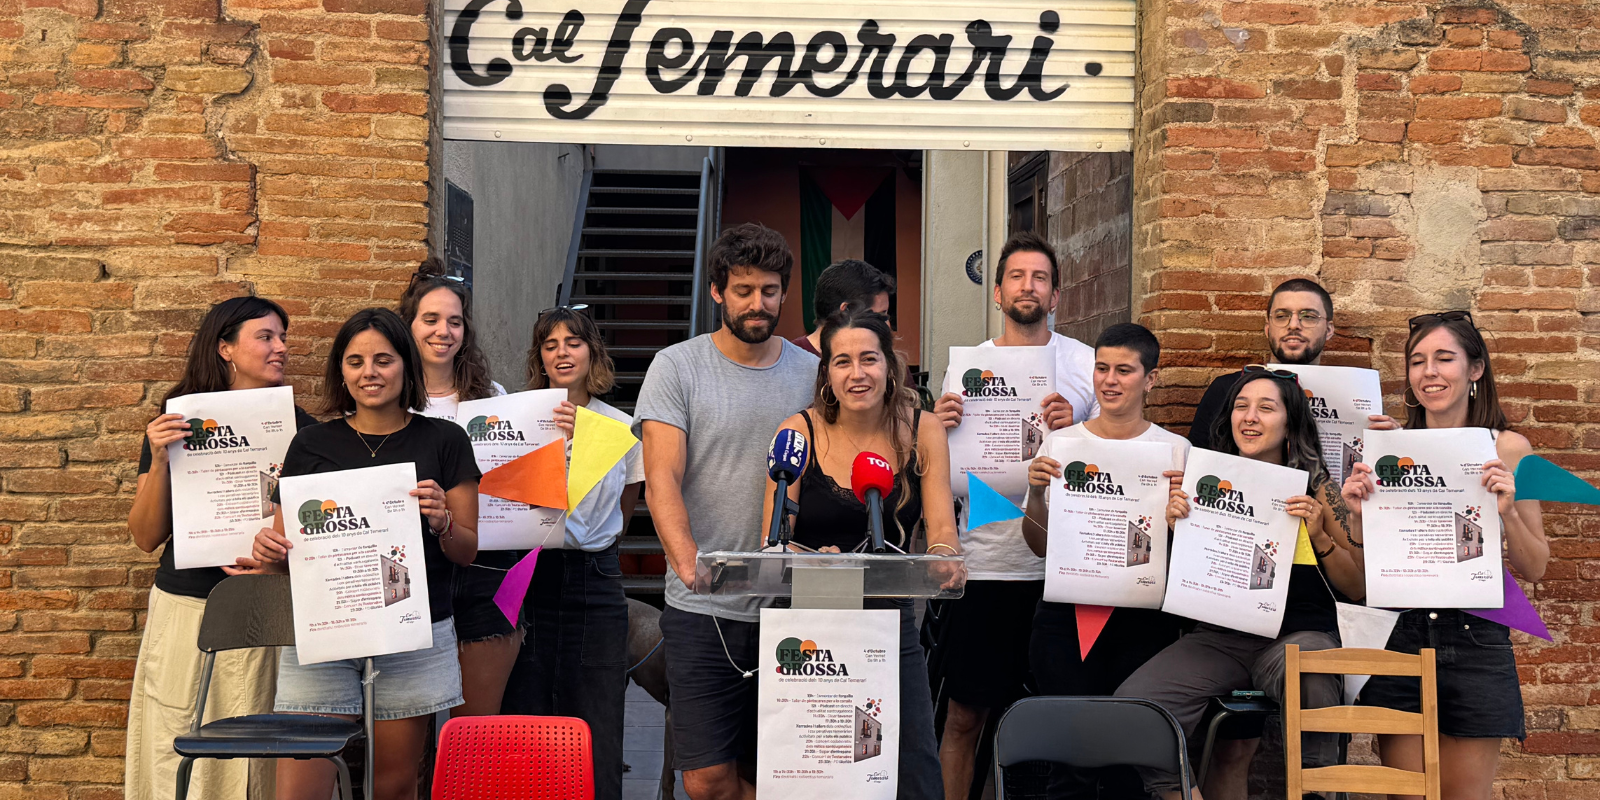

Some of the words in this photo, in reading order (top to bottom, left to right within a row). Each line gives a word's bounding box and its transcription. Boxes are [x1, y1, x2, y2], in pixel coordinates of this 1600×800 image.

[447, 0, 586, 86] Cal
[966, 376, 1007, 386] FESTA
[966, 387, 1018, 398] GROSSA
[192, 425, 235, 439] ESTA
[470, 420, 513, 432] FESTA
[186, 436, 250, 451] GROSSA
[470, 431, 526, 442] GROSSA
[867, 457, 890, 471] TOT
[1380, 465, 1432, 476] FESTA
[1067, 470, 1112, 484] FESTA
[1381, 476, 1447, 487] GROSSA
[1068, 480, 1124, 496] GROSSA
[1199, 483, 1244, 503] FESTA
[1197, 496, 1255, 517] GROSSA
[302, 506, 354, 523] FESTA
[304, 516, 370, 536] GROSSA
[780, 649, 834, 662] FESTA
[780, 663, 849, 676] GROSSA
